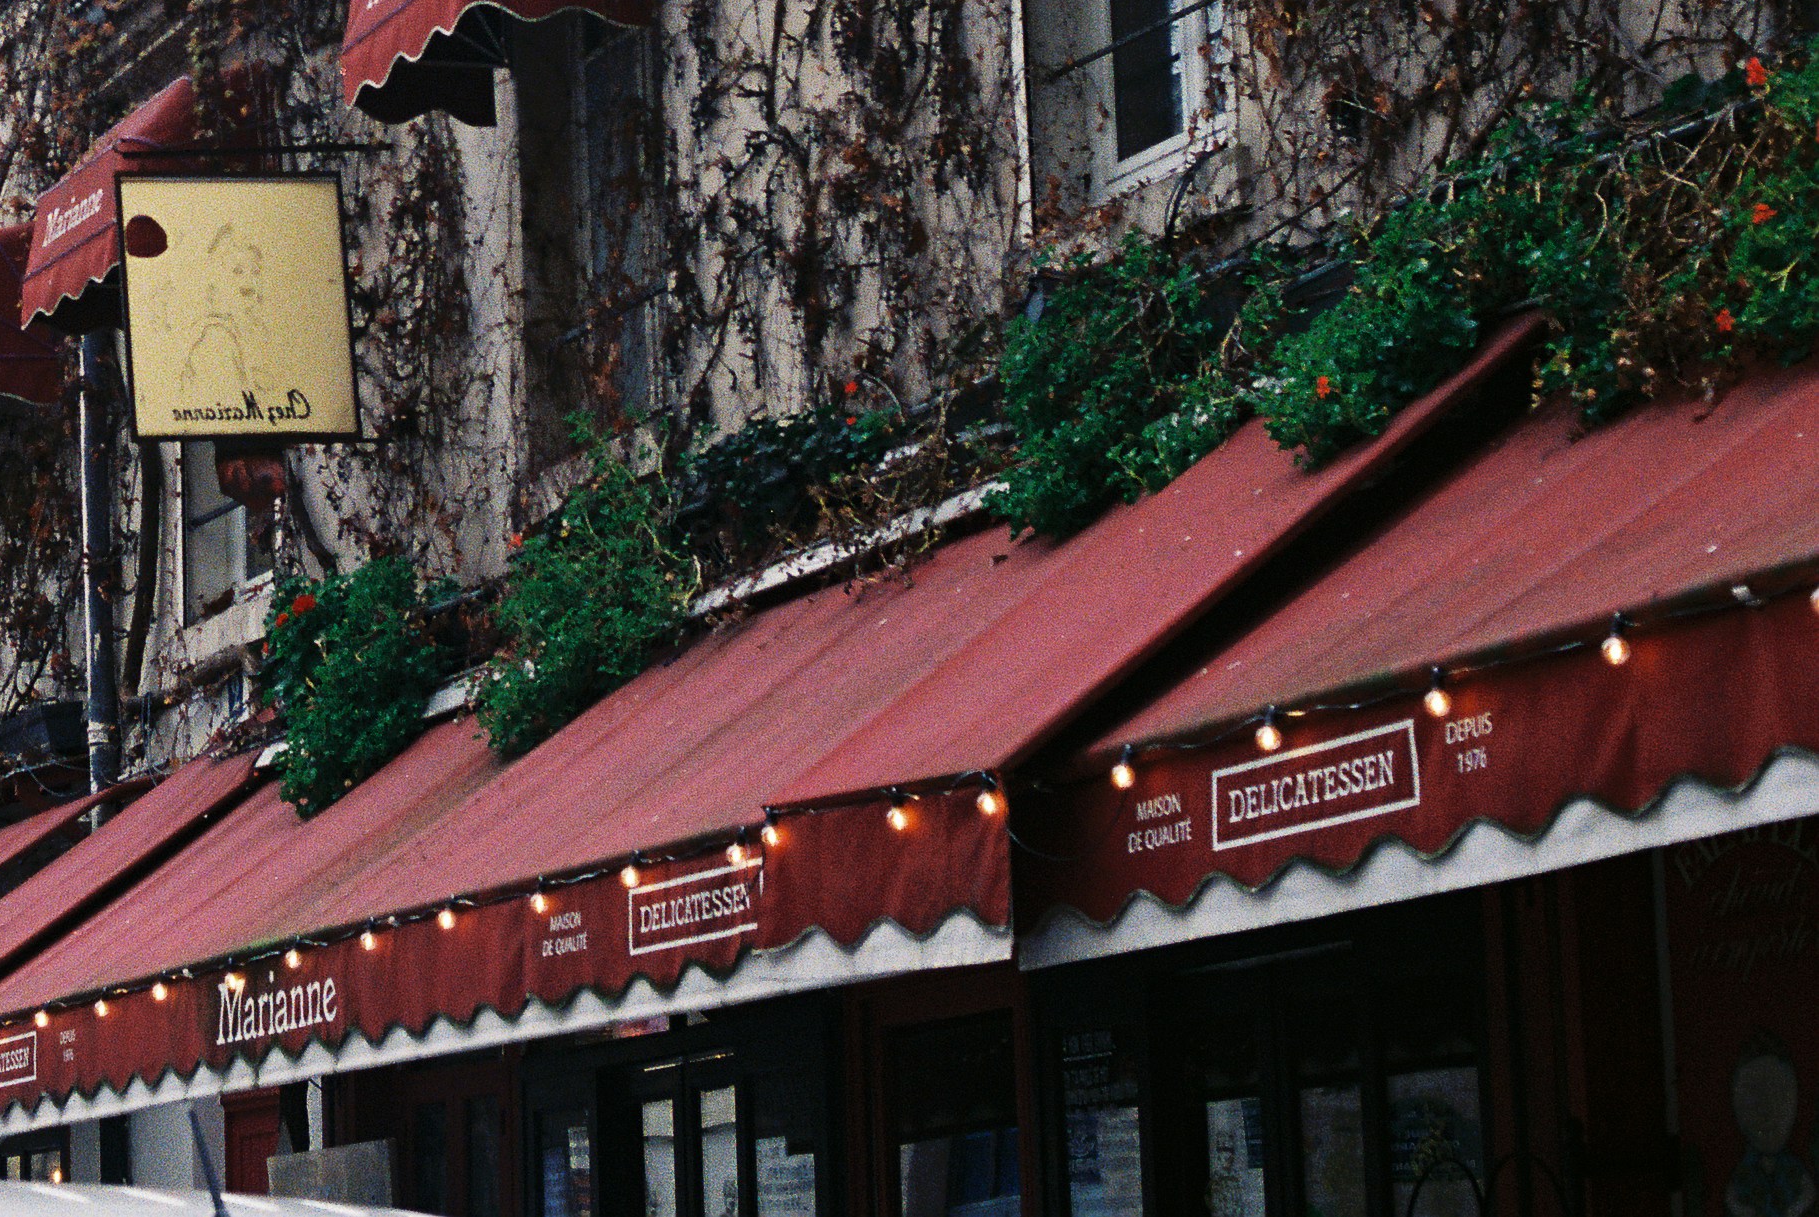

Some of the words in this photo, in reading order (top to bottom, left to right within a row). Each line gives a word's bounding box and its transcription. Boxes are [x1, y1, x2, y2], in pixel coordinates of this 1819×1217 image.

[1445, 712, 1492, 744] DEPUIS
[1457, 746, 1487, 773] 1976
[1229, 751, 1396, 823] DELICATESSEN
[1136, 793, 1181, 821] MAISON
[1128, 831, 1143, 853] DE
[549, 911, 581, 932] MAISON
[216, 971, 337, 1046] Marianne
